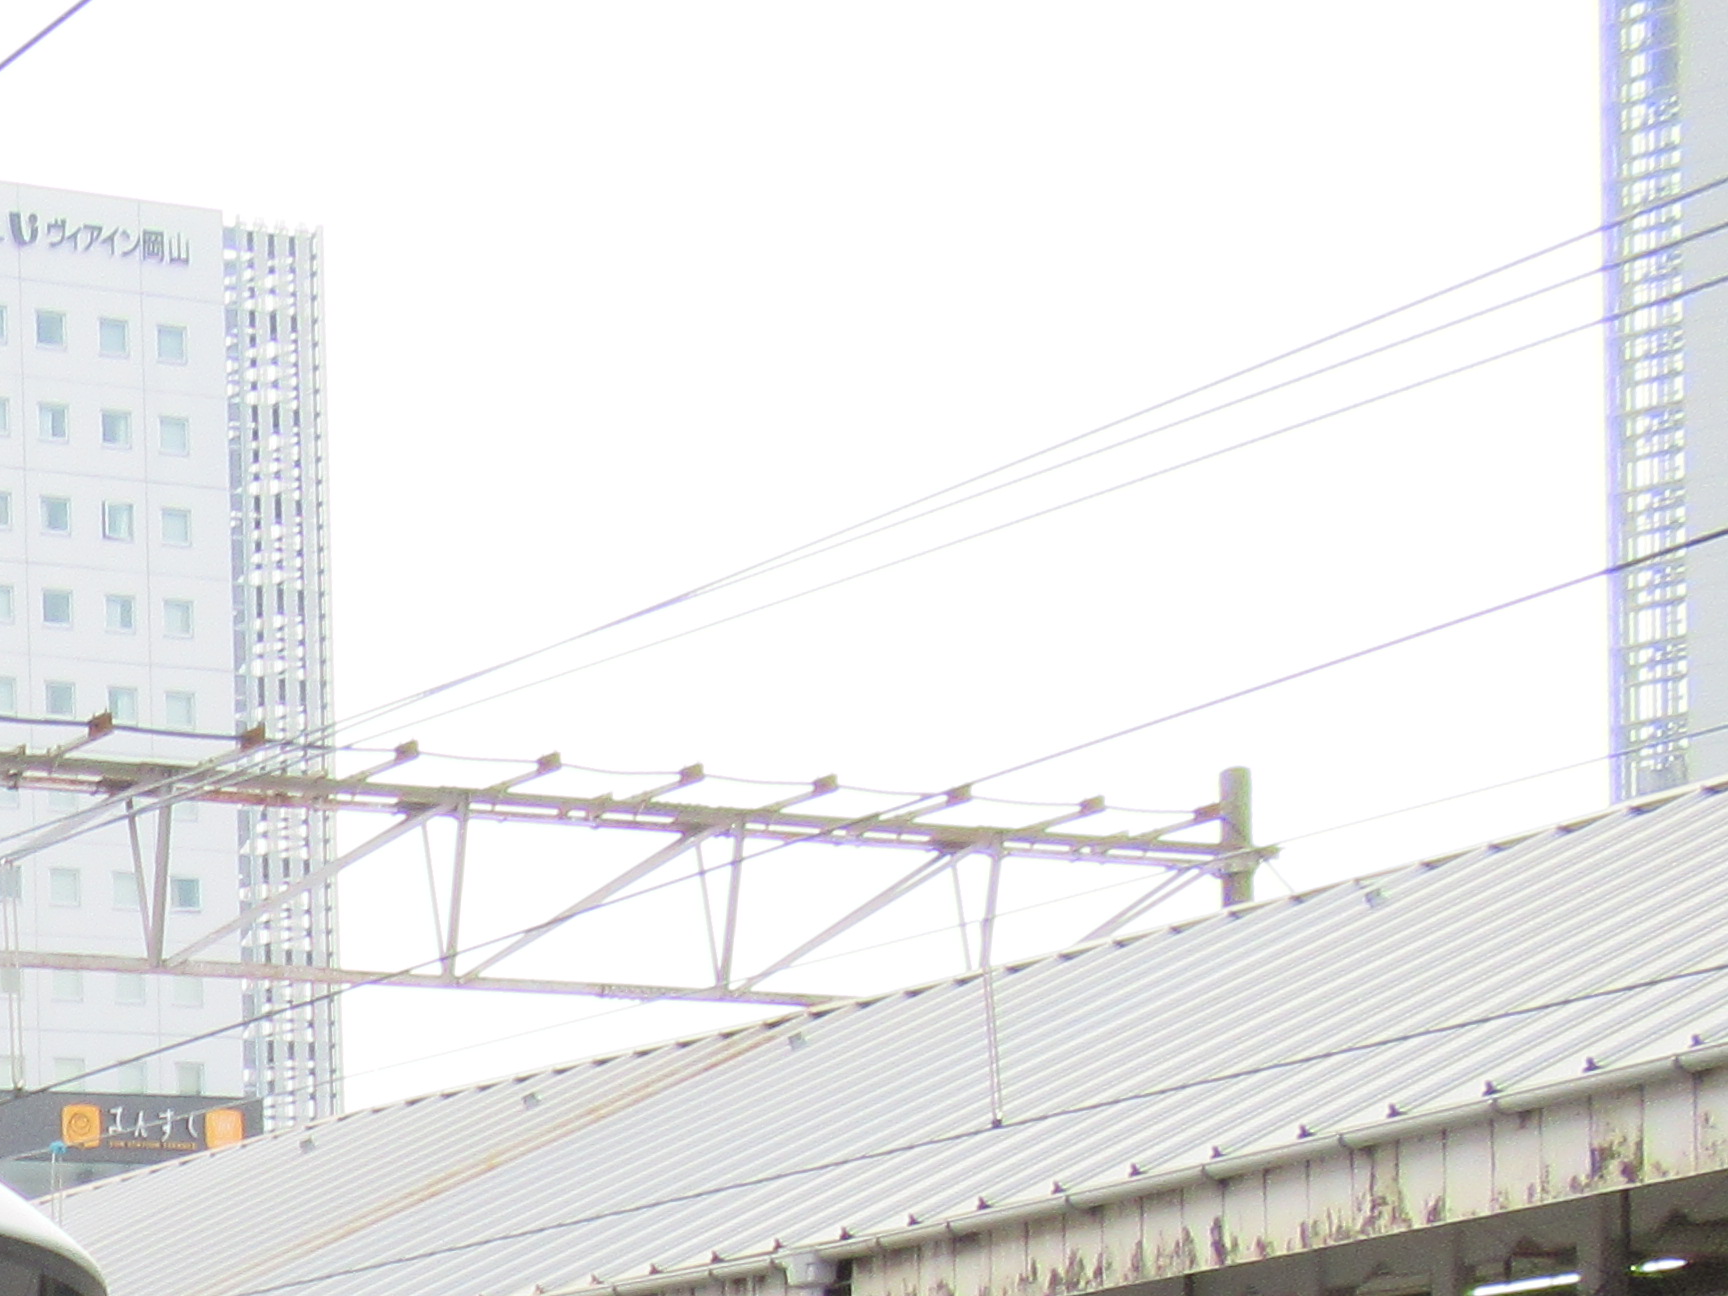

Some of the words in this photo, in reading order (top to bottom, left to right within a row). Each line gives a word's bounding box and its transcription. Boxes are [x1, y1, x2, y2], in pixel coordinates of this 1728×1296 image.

[46, 217, 190, 265] ヴィアイン岡山
